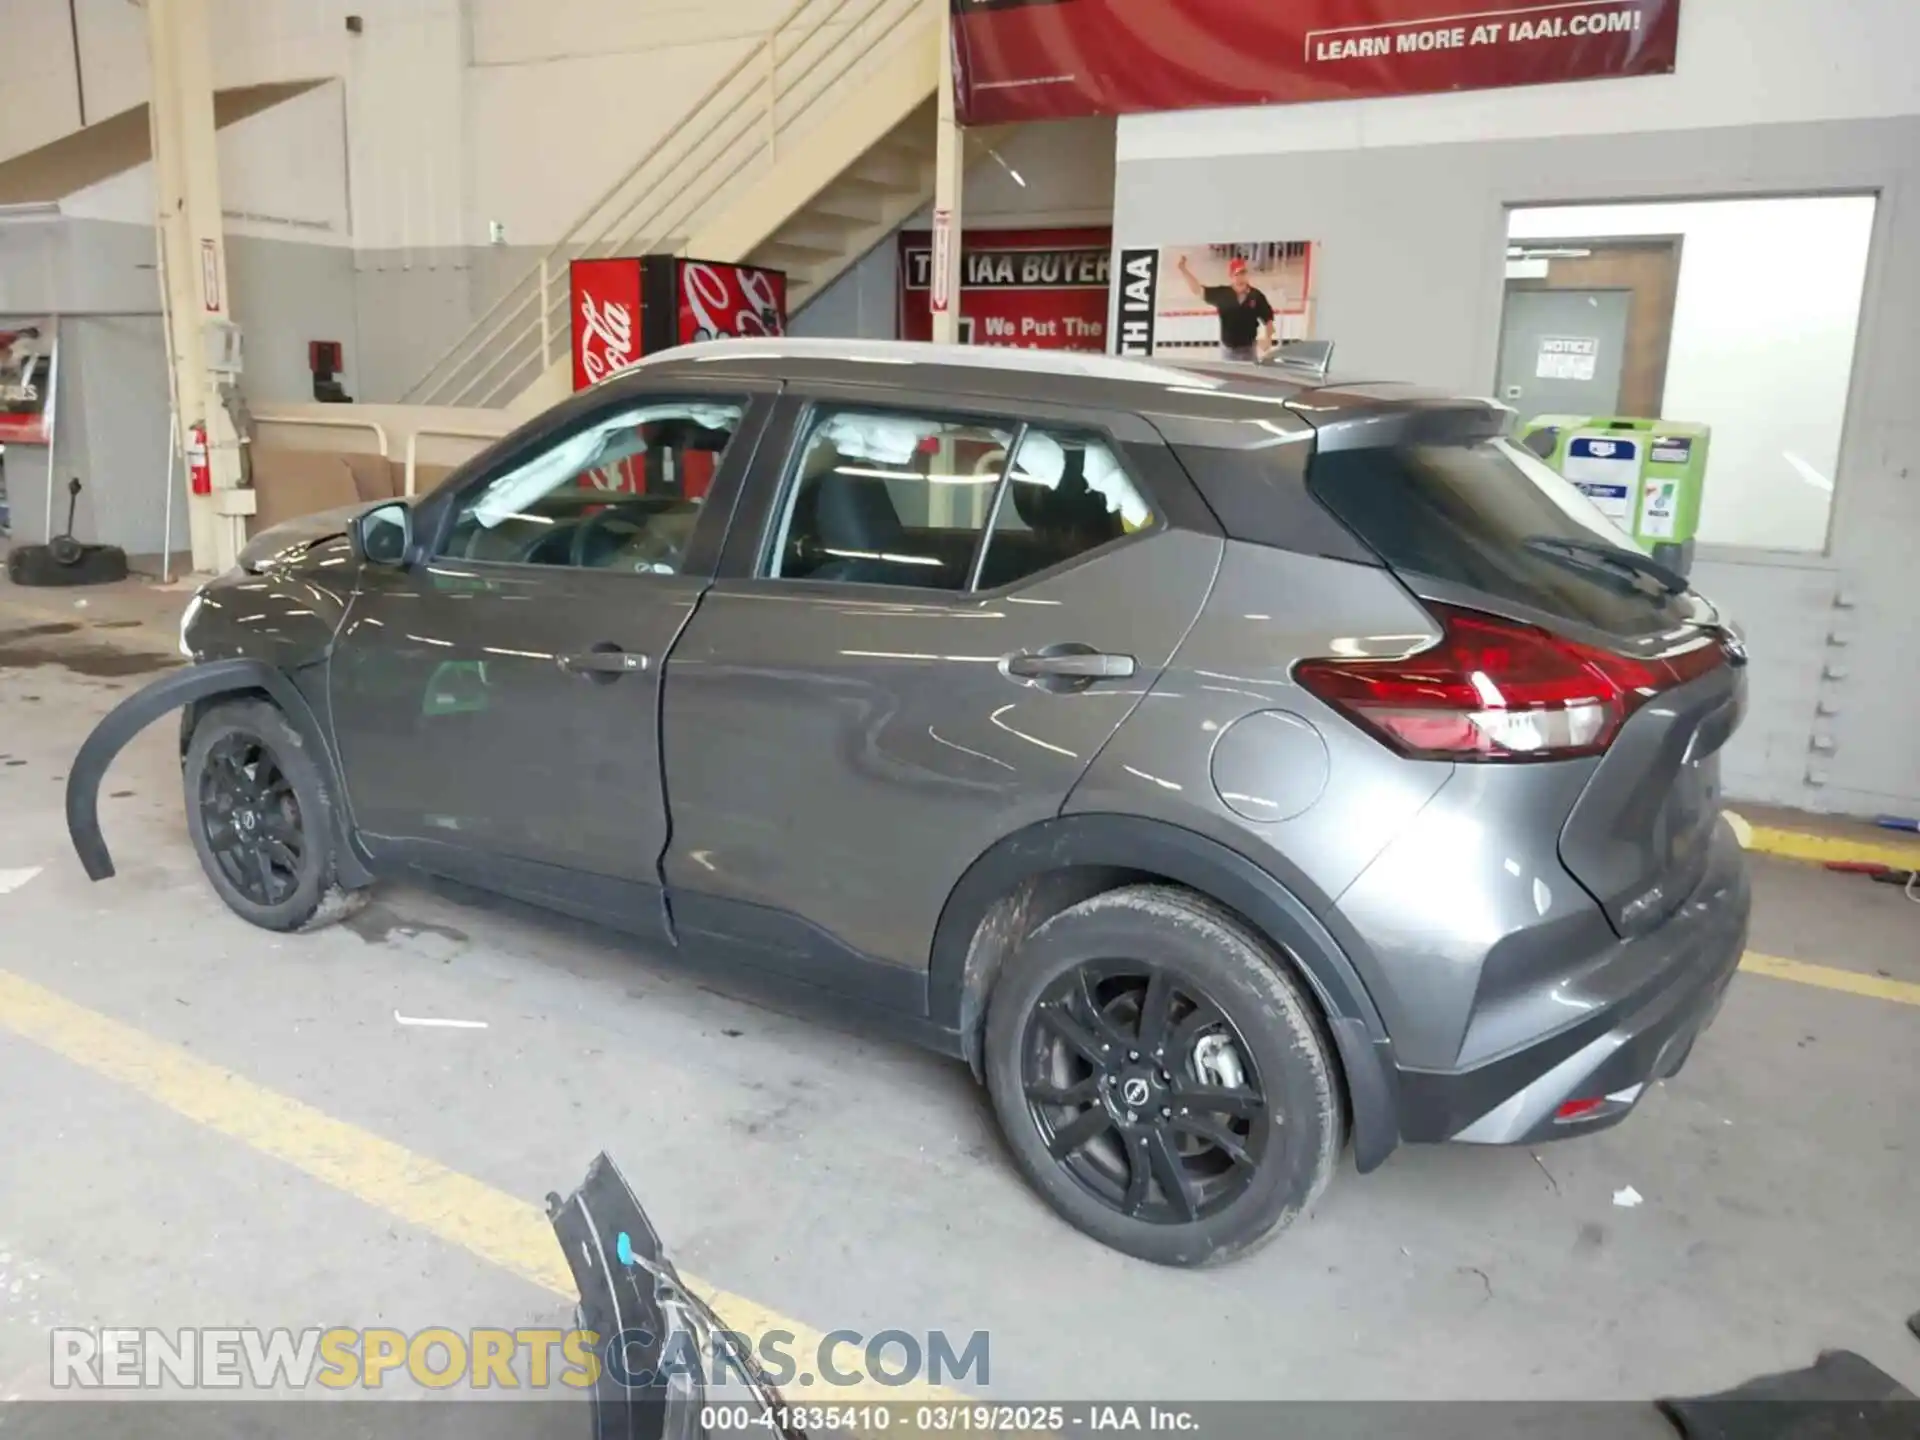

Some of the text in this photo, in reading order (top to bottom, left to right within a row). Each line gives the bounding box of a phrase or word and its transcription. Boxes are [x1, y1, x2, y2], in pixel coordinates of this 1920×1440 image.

[1317, 11, 1642, 61] LEARN MORE AT IAAI.COM!
[968, 255, 1015, 283] IAA
[1124, 256, 1152, 311] IAA
[985, 317, 1102, 336] We Put The
